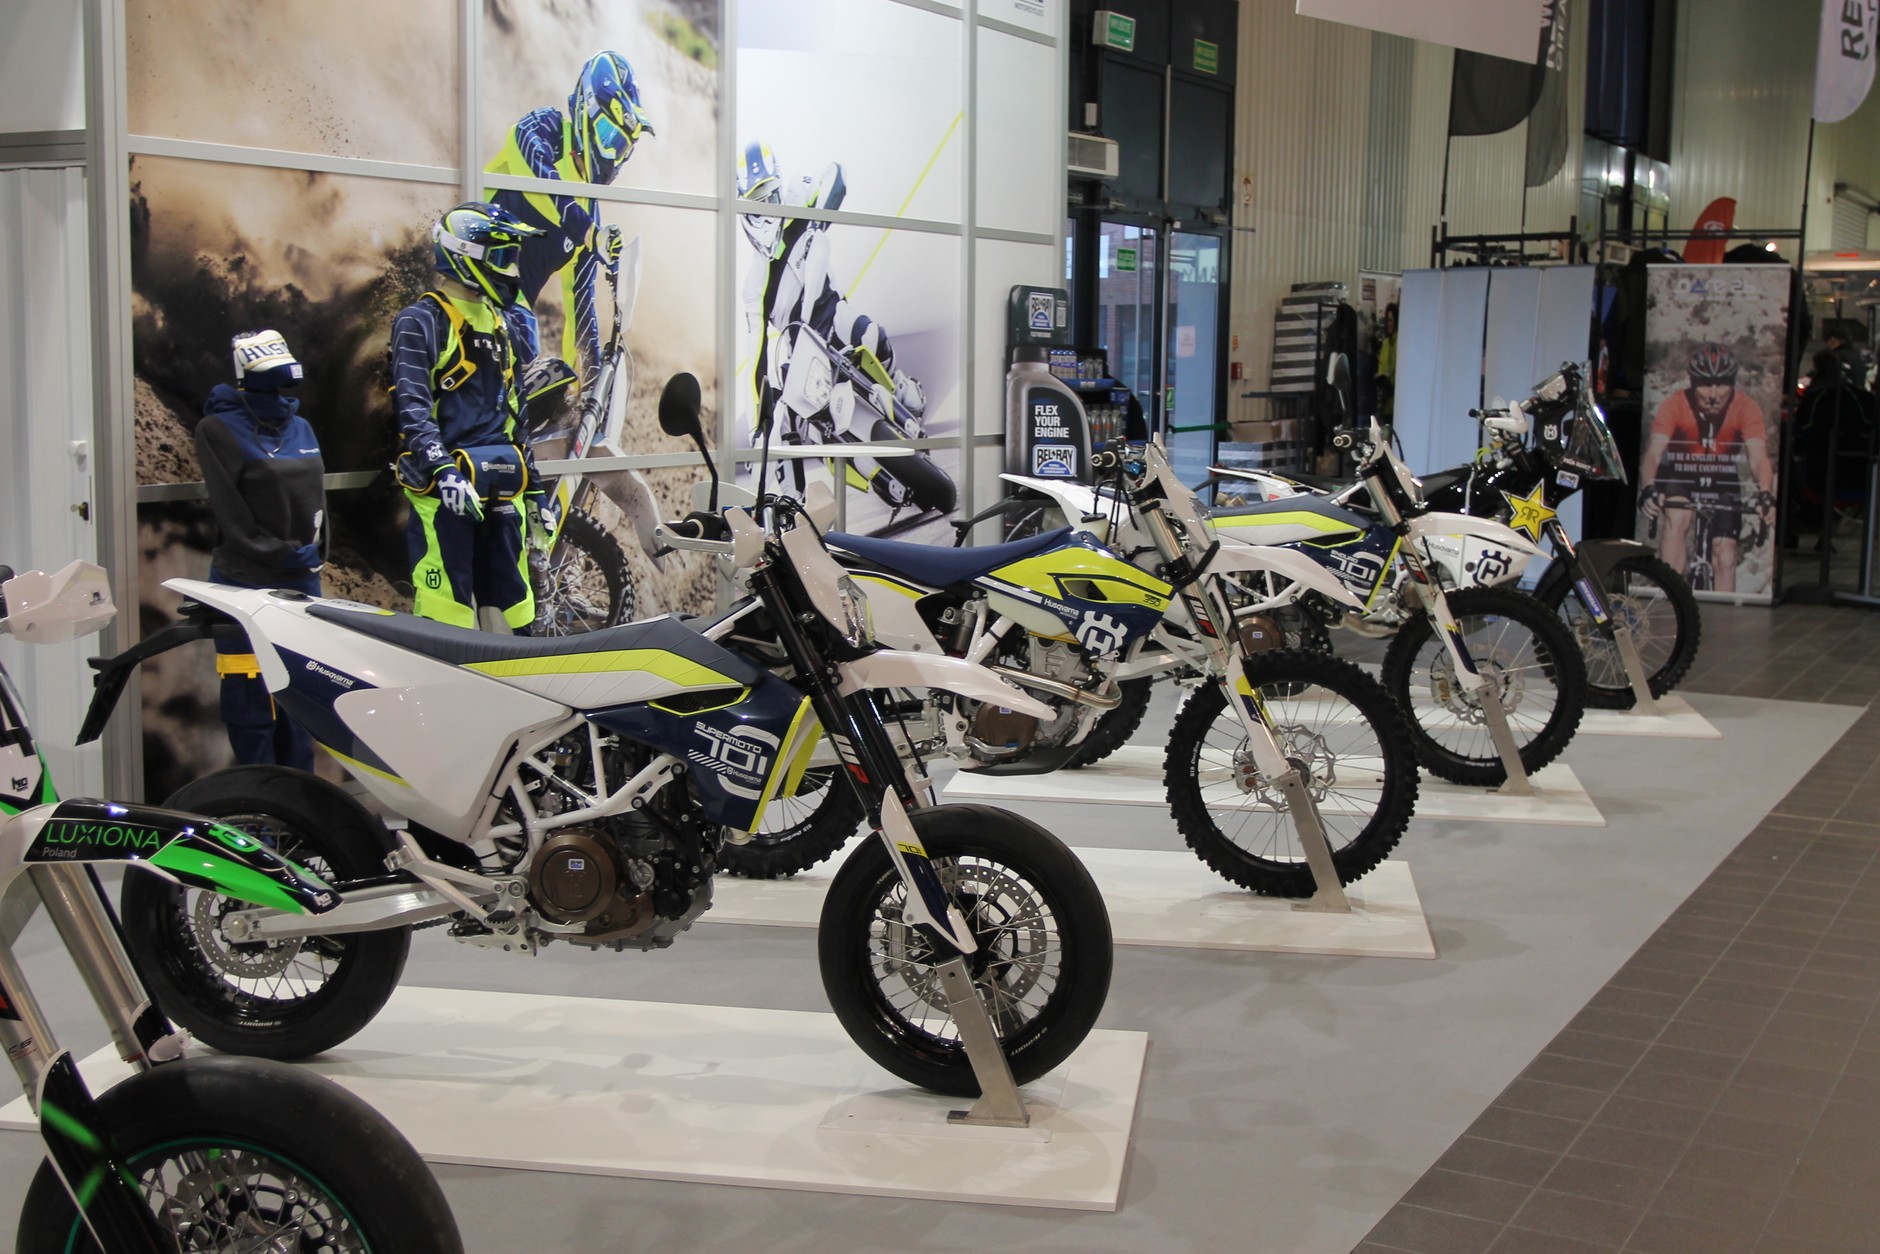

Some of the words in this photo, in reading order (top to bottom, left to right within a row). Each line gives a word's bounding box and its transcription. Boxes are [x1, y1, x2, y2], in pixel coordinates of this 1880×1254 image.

[1034, 405, 1058, 416] FLEX
[1034, 416, 1061, 427] YOUR
[1034, 427, 1070, 438] ENGINE
[1674, 463, 1682, 472] TO
[1698, 464, 1737, 473] EVERYTHING
[1330, 554, 1377, 582] 701
[1044, 599, 1080, 617] Husqvarna
[314, 664, 354, 686] Husqvarna
[695, 721, 762, 754] SUPERMOTO
[694, 728, 768, 775] 701
[732, 770, 762, 783] Husqvarna
[46, 823, 160, 850] LUXIONA
[42, 847, 78, 858] Poland
[897, 843, 923, 854] 701
